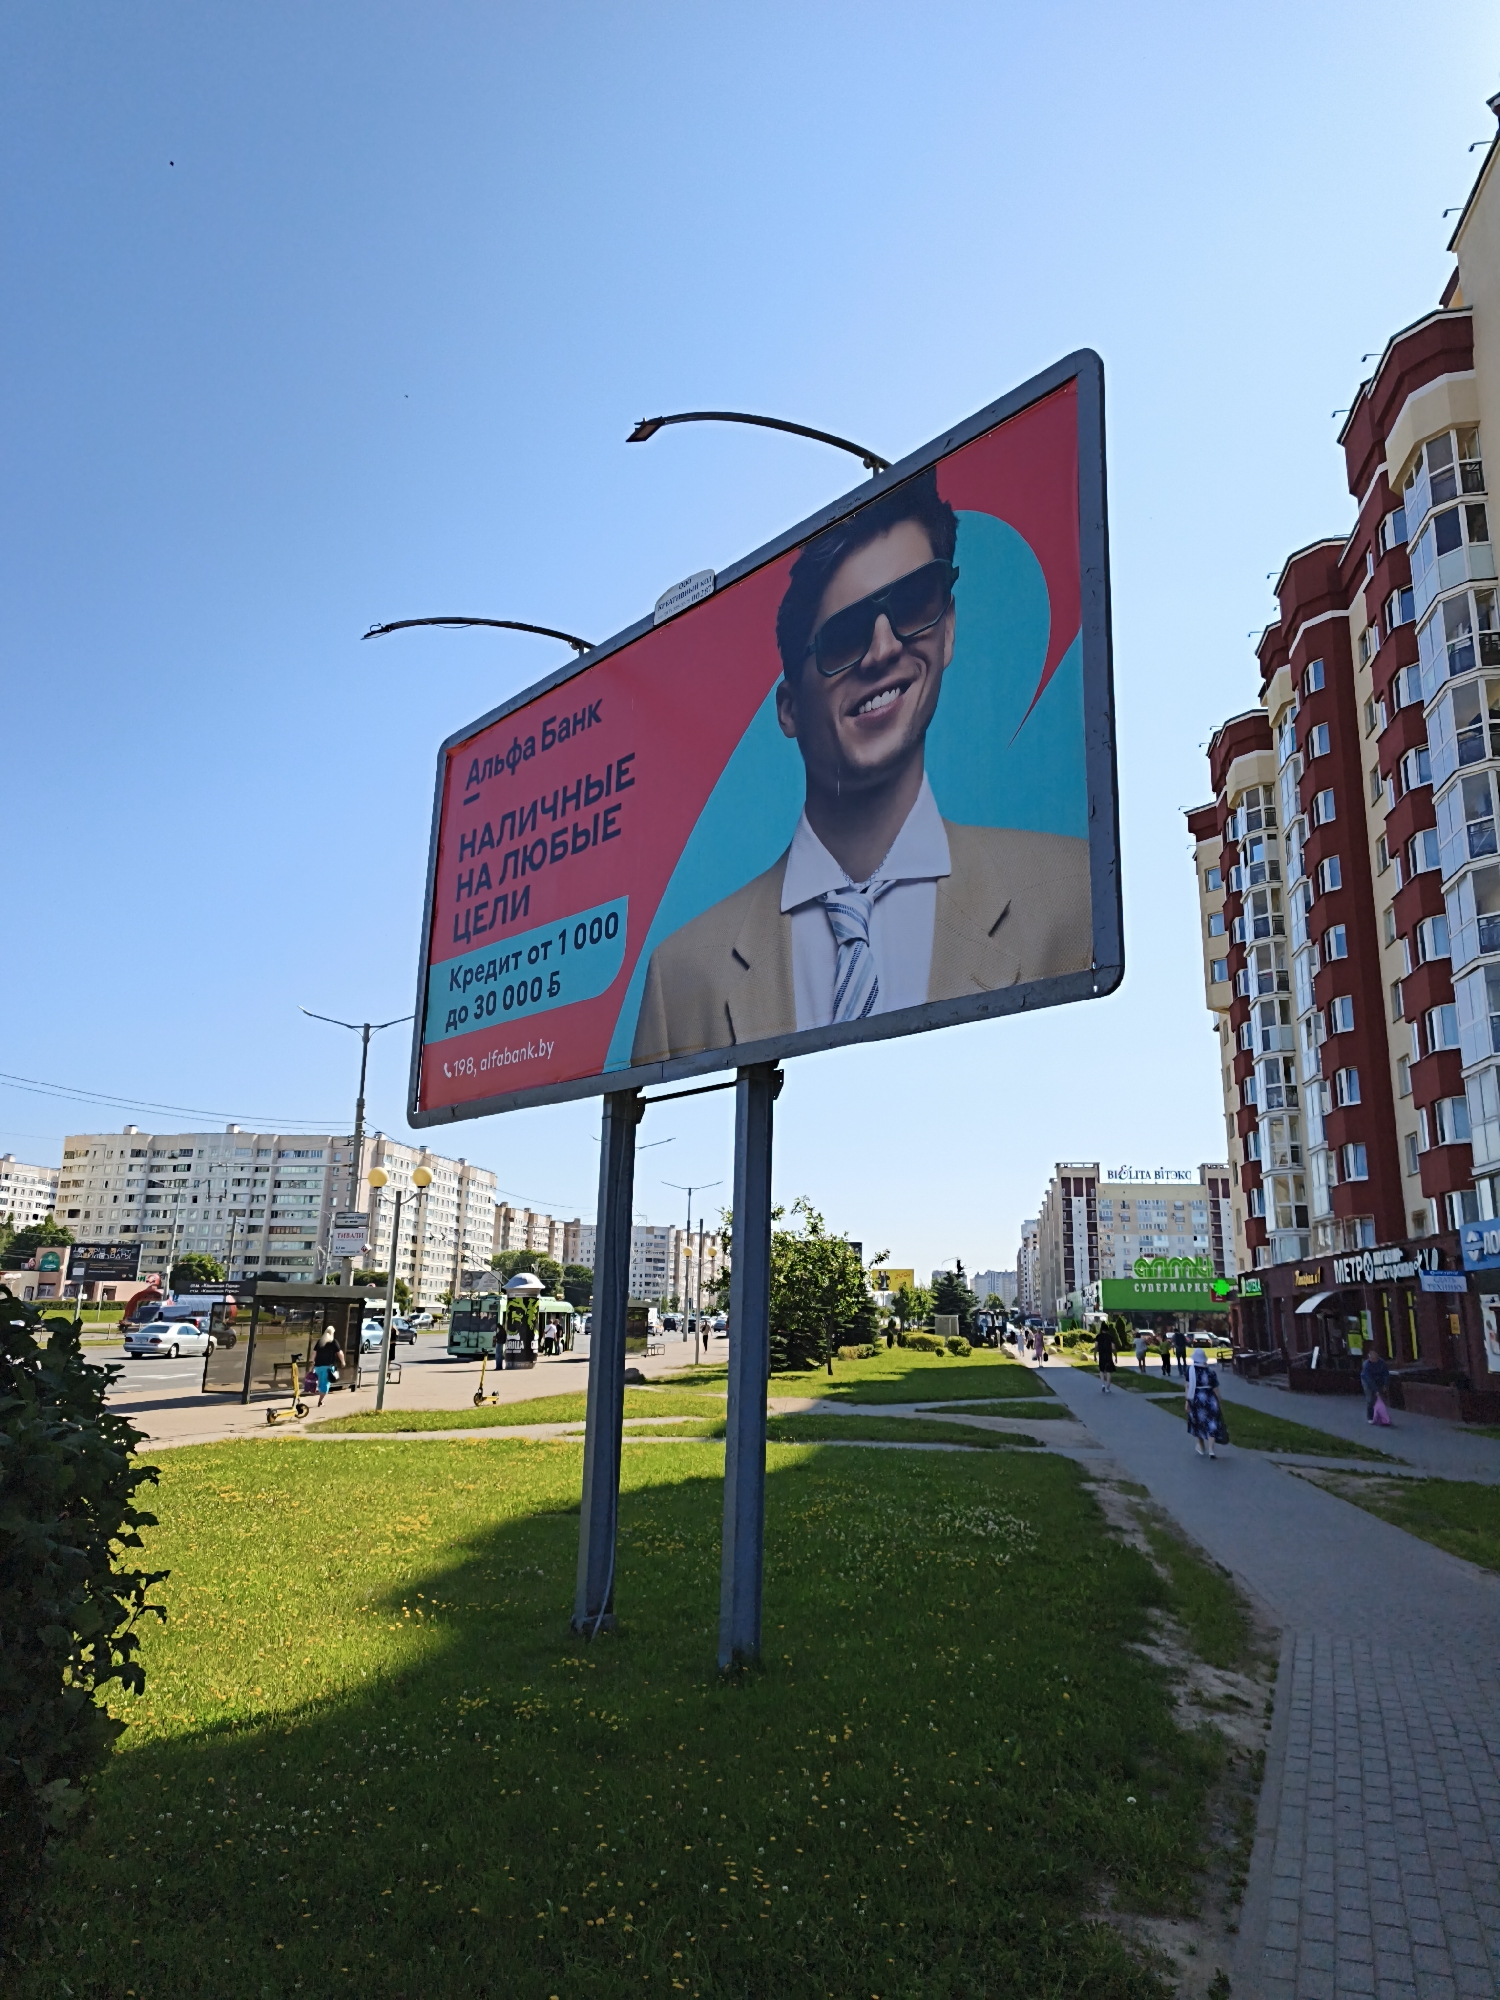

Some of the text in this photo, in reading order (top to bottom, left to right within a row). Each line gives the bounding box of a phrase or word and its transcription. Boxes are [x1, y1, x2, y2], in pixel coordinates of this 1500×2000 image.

[464, 698, 603, 792] Альфа Банк
[459, 752, 636, 863] НАЛИЧНЫЕ
[456, 803, 622, 902] НА ЛЮБЫЕ
[453, 885, 531, 944] ЦЕЛИ
[449, 950, 523, 993] Кредит
[527, 940, 553, 965] от
[445, 1006, 469, 1033] до
[480, 1039, 555, 1071] alfabank.by
